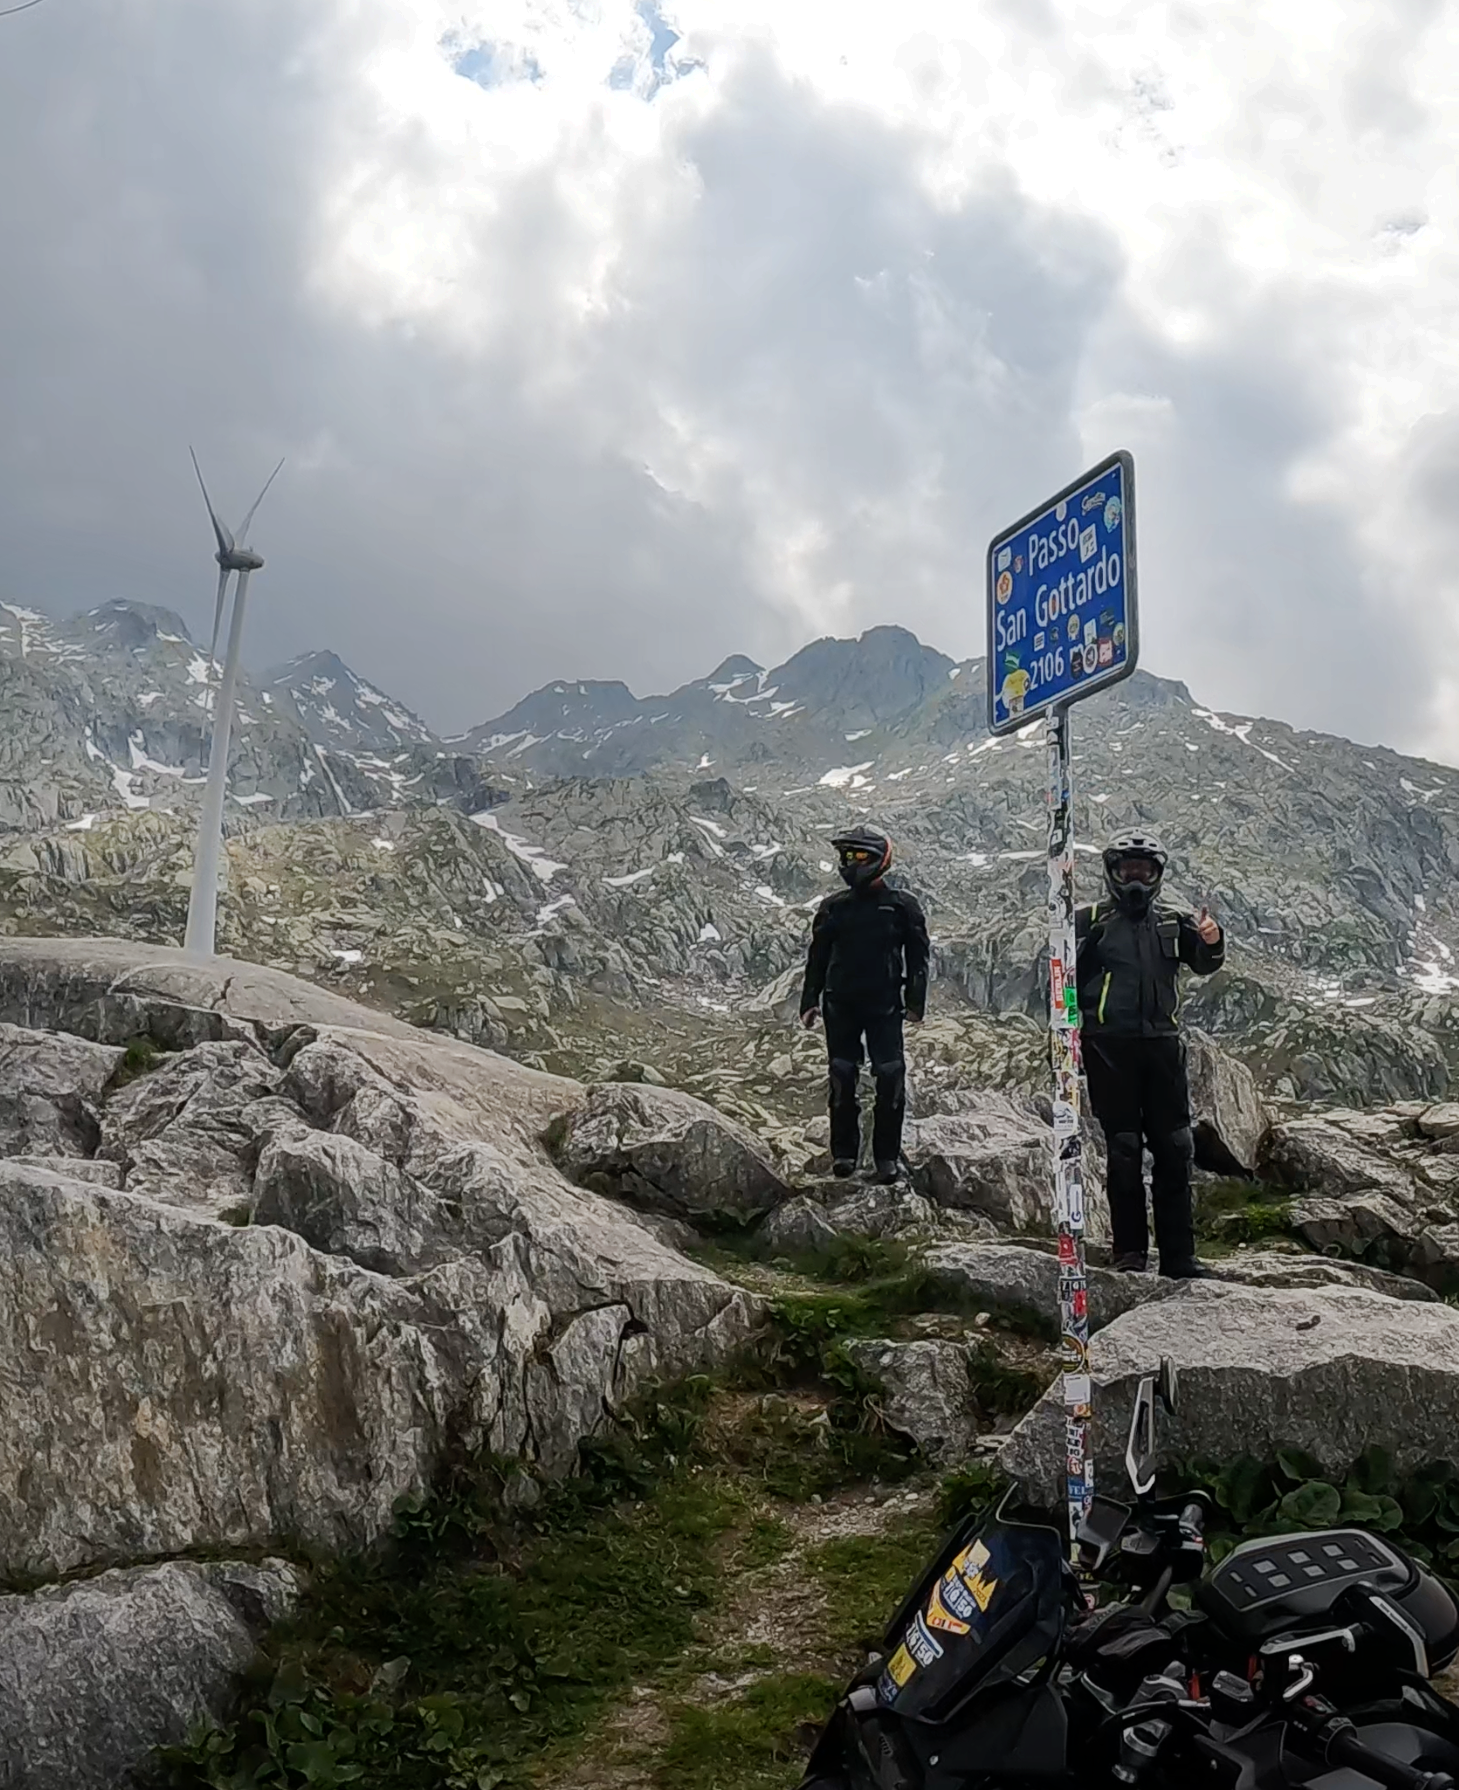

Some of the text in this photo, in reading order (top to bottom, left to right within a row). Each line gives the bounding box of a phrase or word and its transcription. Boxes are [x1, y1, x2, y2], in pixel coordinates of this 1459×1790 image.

[1028, 517, 1079, 577] Passo
[997, 545, 1120, 652] San Gottardo
[1030, 646, 1064, 690] 2106
